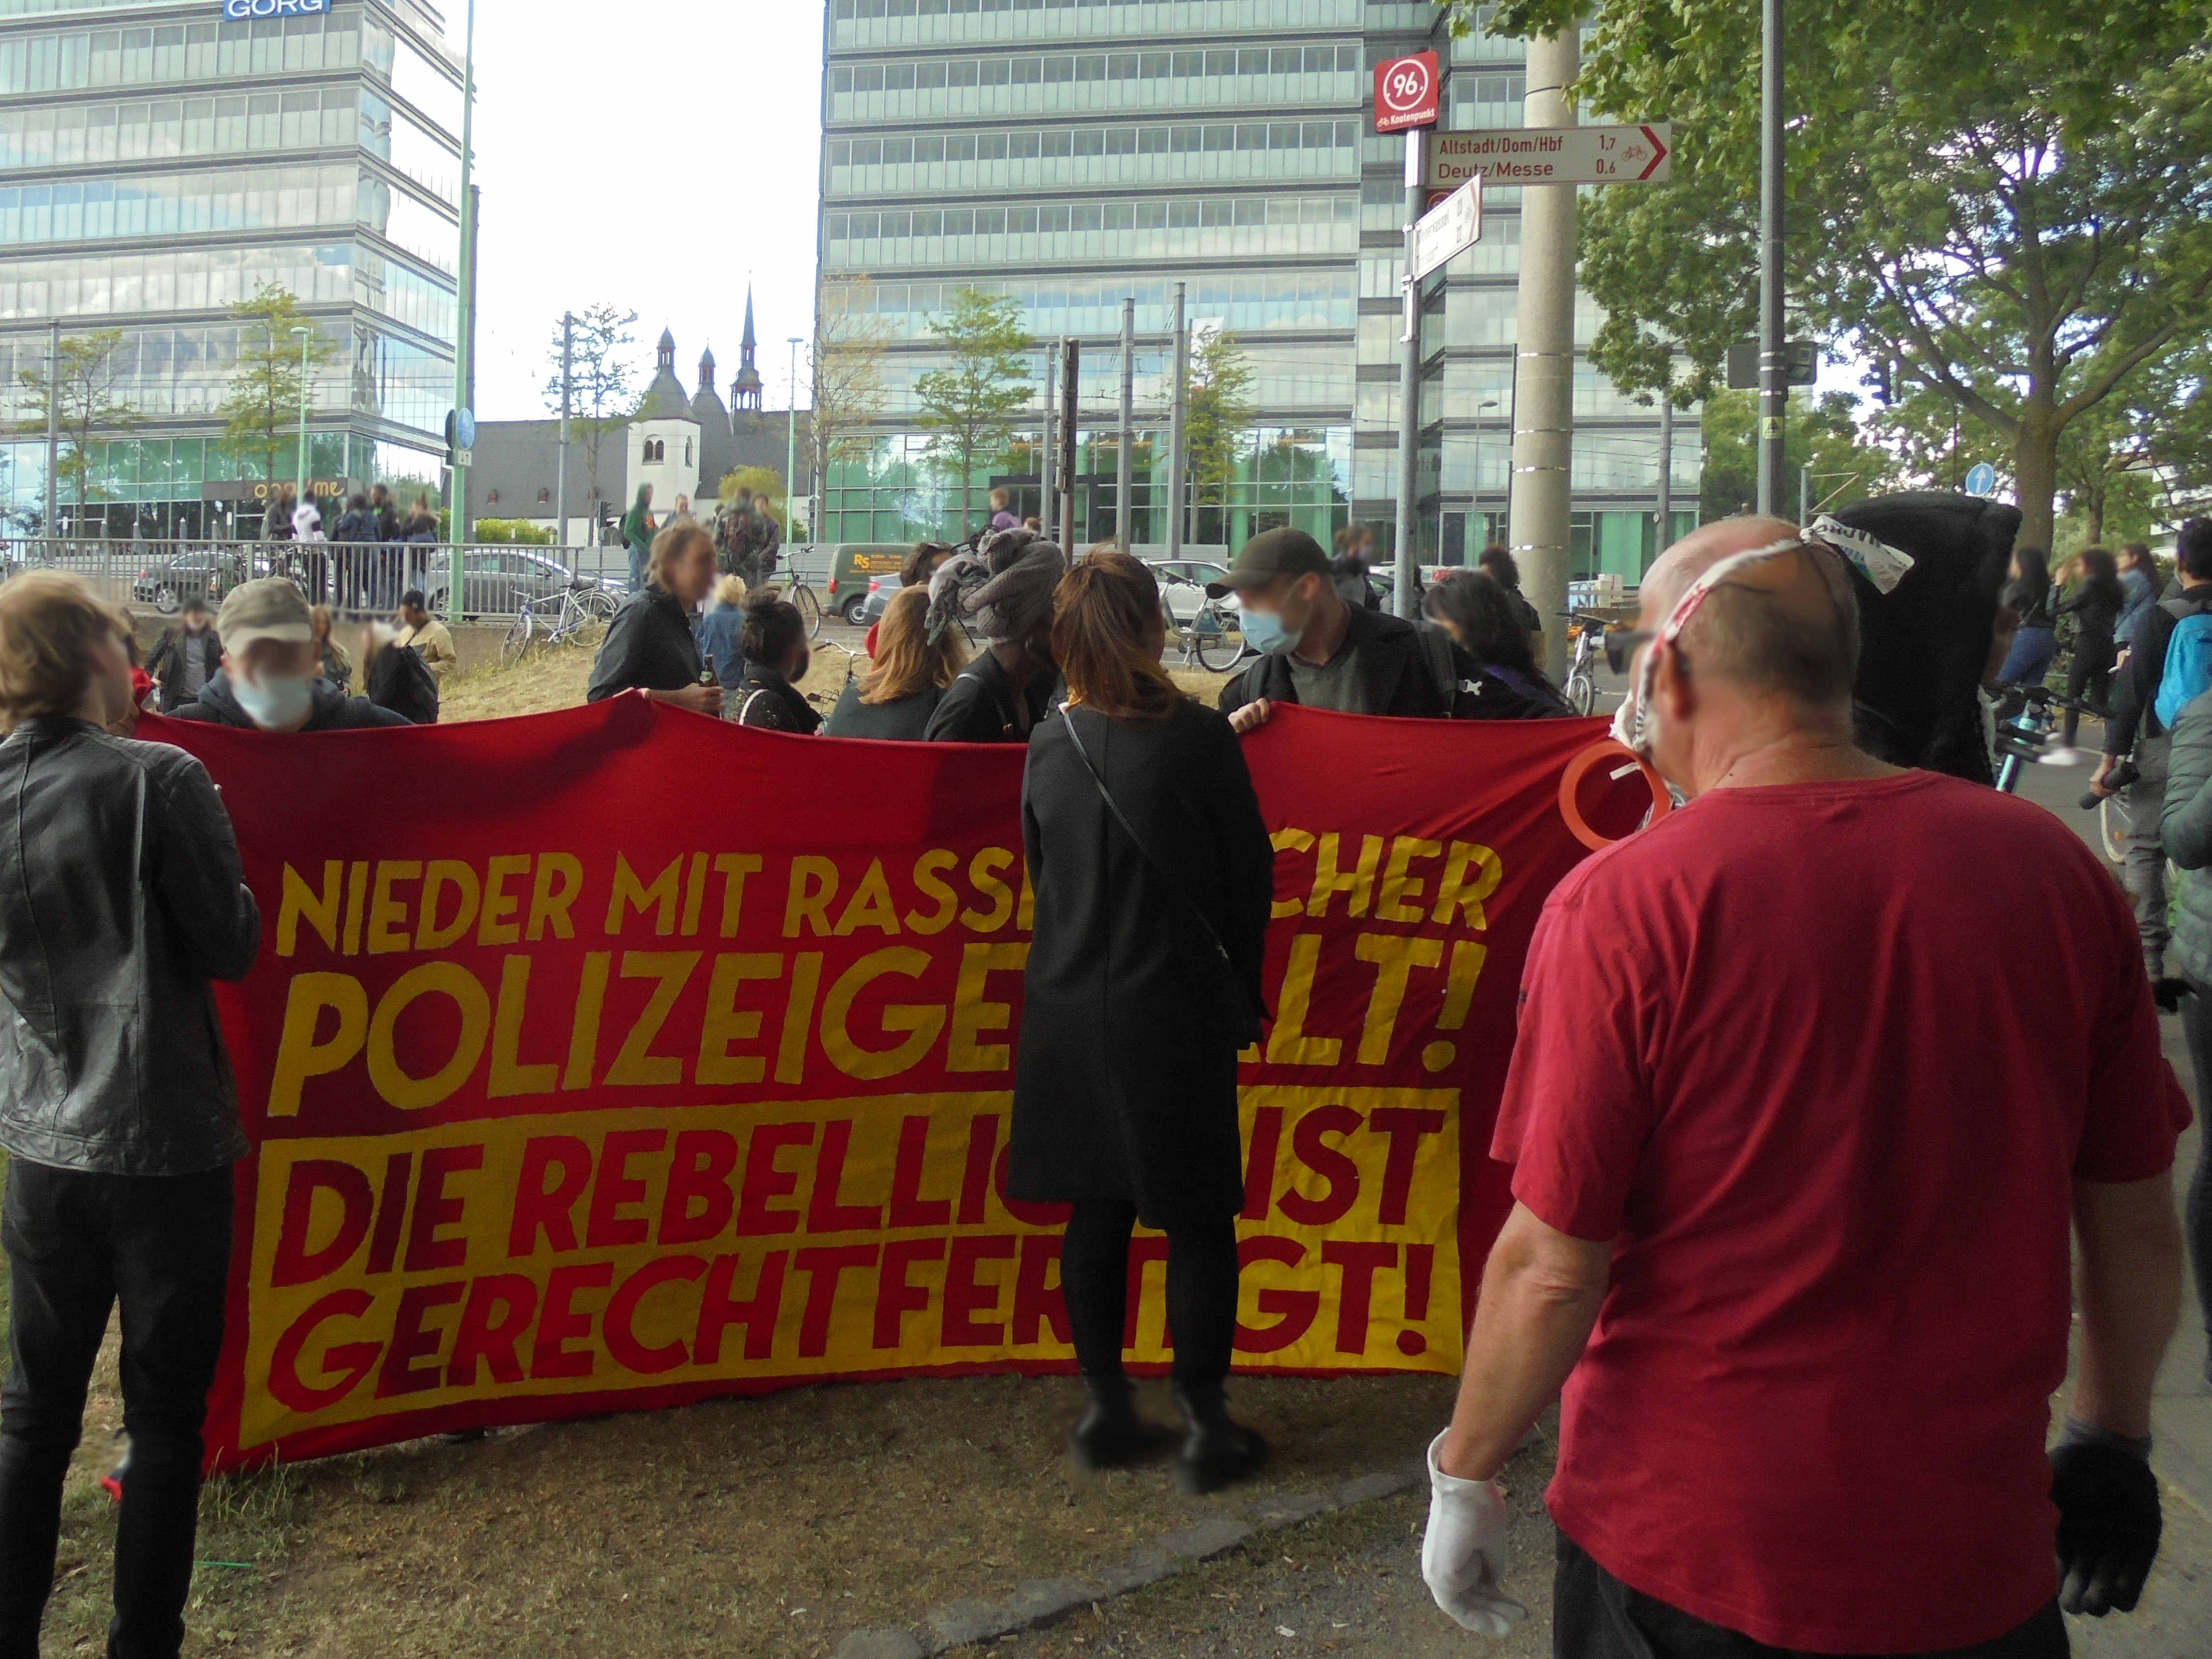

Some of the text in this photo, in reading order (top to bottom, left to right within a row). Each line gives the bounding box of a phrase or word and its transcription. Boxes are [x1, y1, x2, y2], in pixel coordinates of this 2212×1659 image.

[1391, 108, 1435, 125] Knotenpunkt
[1394, 71, 1418, 98] 96
[1438, 162, 1554, 179] Deutz/Messe
[1440, 136, 1564, 155] Altstadt/Dom/Hbf
[276, 827, 1502, 956] NIEDER MIT RASSICHER
[267, 933, 1486, 1117] POLIZEIGELT!
[270, 1105, 1446, 1288] DIE REBELLI IST
[266, 1234, 1434, 1412] GERECHTFERTGT!
